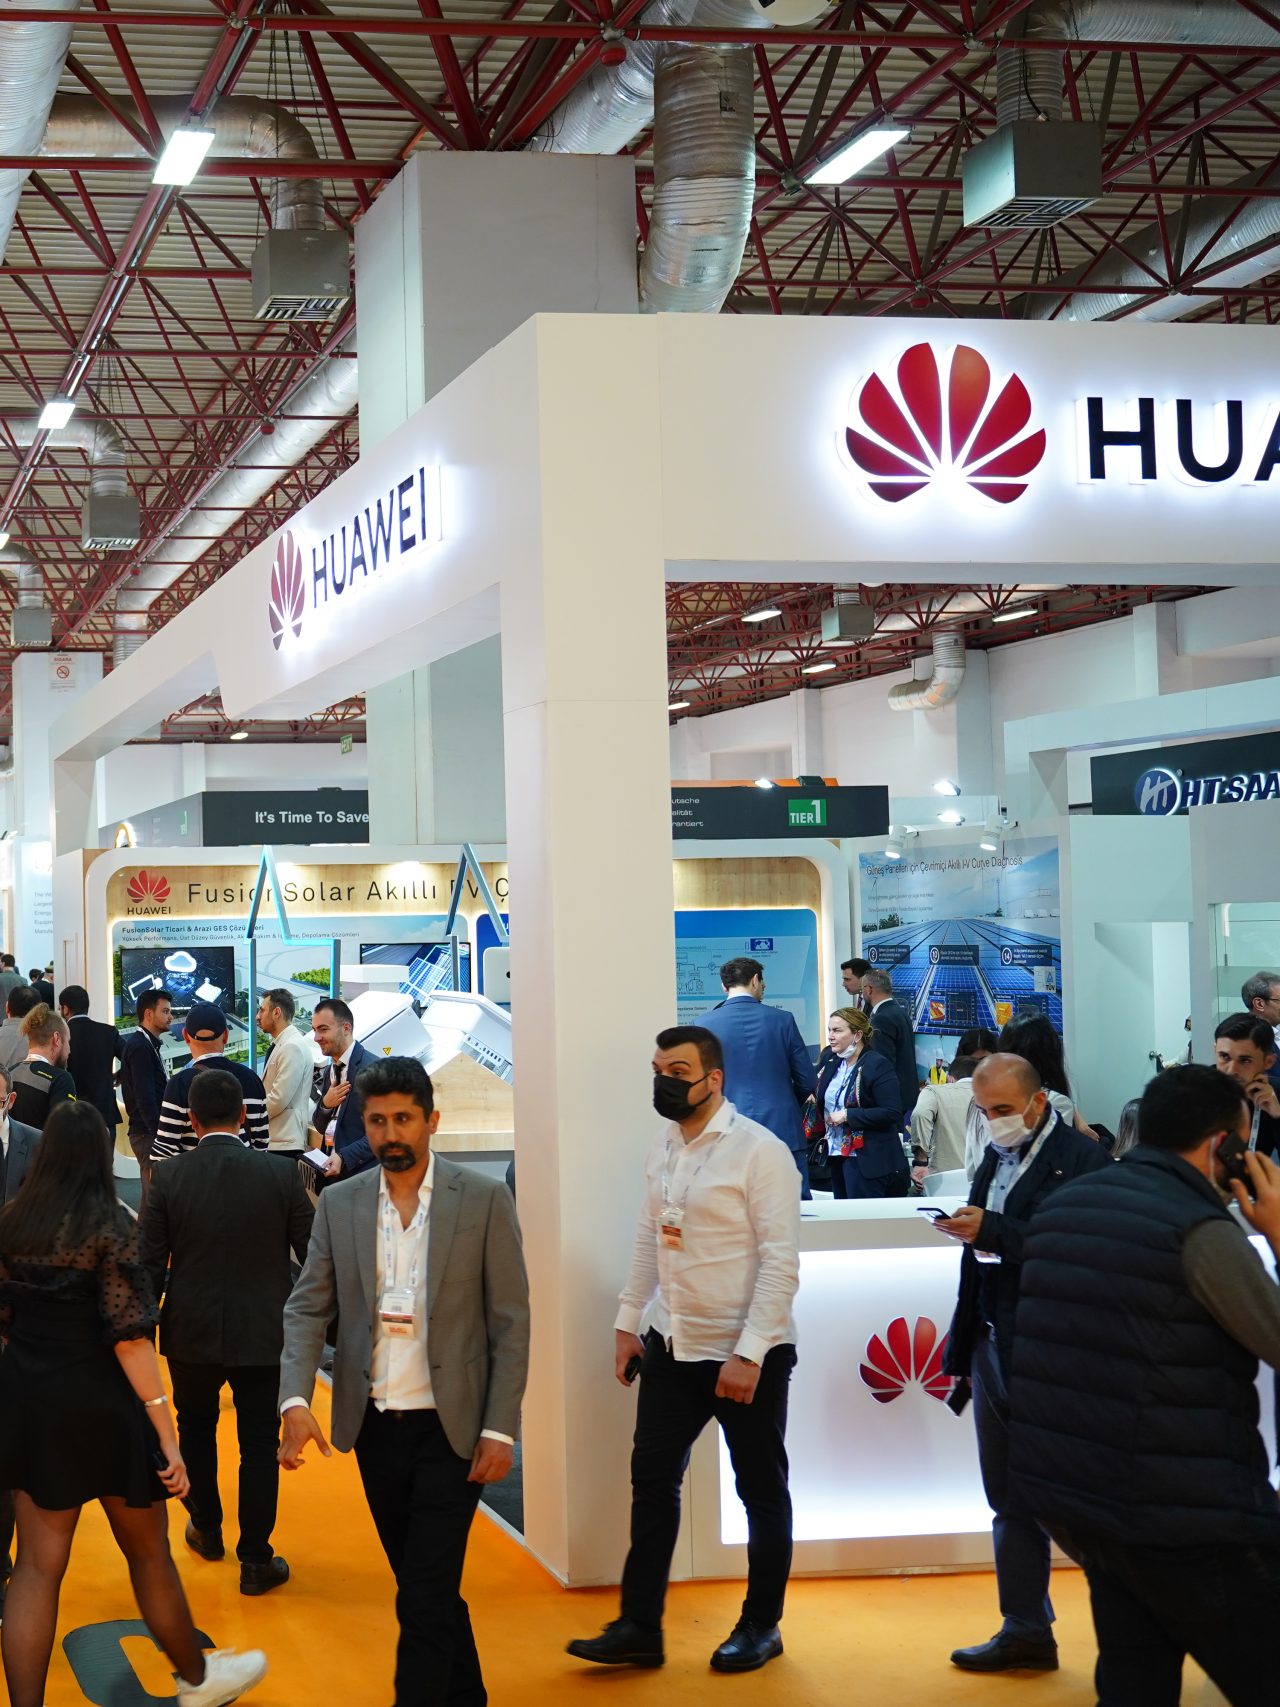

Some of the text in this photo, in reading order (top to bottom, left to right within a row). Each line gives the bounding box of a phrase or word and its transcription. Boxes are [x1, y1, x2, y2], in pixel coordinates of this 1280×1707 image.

[312, 467, 427, 609] HUAWEI
[255, 811, 369, 823] It's Time To Save
[811, 799, 821, 824] 1
[790, 812, 814, 824] TIER
[971, 857, 990, 869] Curve
[367, 880, 437, 901] Akıllı
[127, 906, 171, 915] HUAWEI
[122, 926, 164, 934] FusionSolar
[229, 925, 264, 933] Çözüeri
